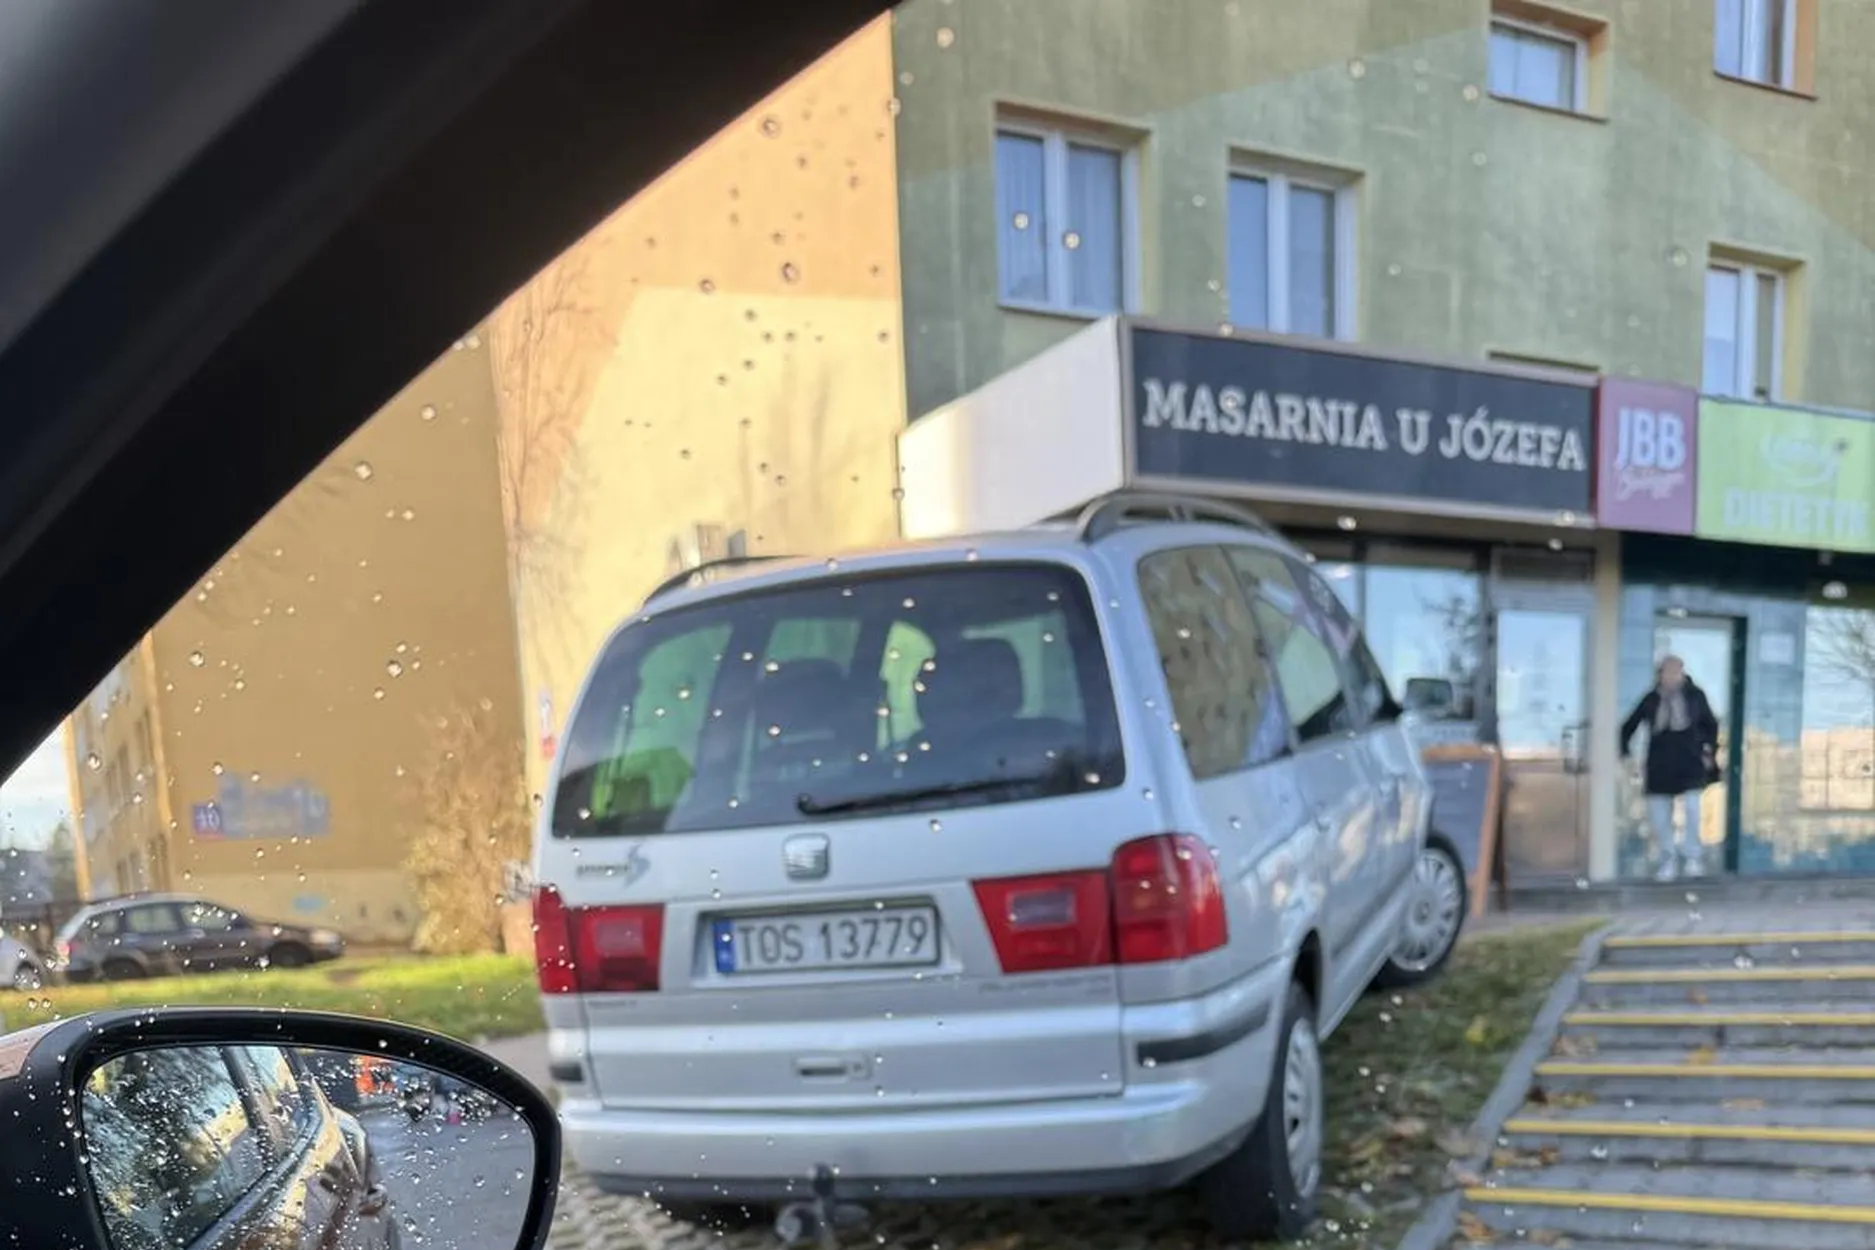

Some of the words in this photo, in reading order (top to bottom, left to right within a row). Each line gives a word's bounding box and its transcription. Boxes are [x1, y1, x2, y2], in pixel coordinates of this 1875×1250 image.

[1143, 378, 1387, 450] MASARNIA
[1396, 408, 1433, 455] U
[1439, 405, 1586, 471] JÓZEFA
[1616, 408, 1686, 470] JBB
[738, 923, 804, 964] TOS
[819, 915, 928, 962] 13779
